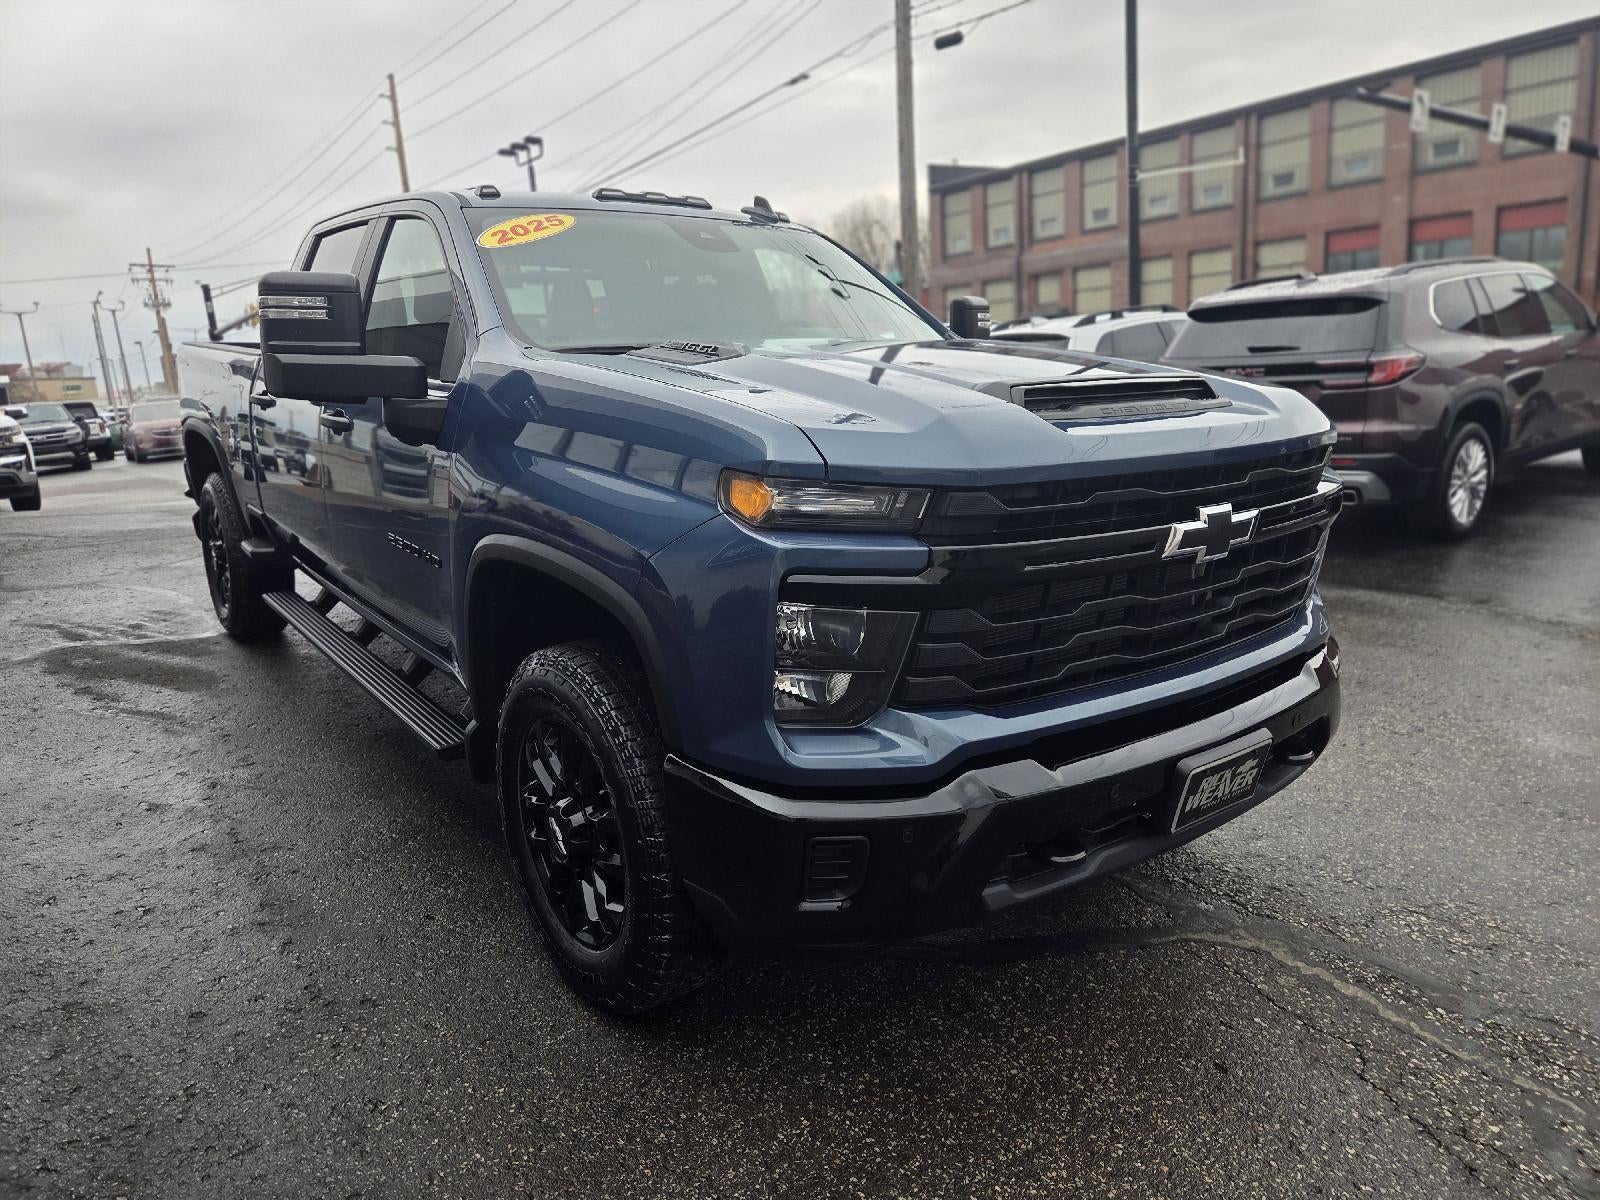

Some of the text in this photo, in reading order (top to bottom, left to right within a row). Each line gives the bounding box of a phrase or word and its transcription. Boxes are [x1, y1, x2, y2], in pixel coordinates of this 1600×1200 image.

[490, 215, 565, 244] 2025
[1099, 402, 1188, 416] CHEVROLET
[1185, 768, 1259, 813] WEAVER
